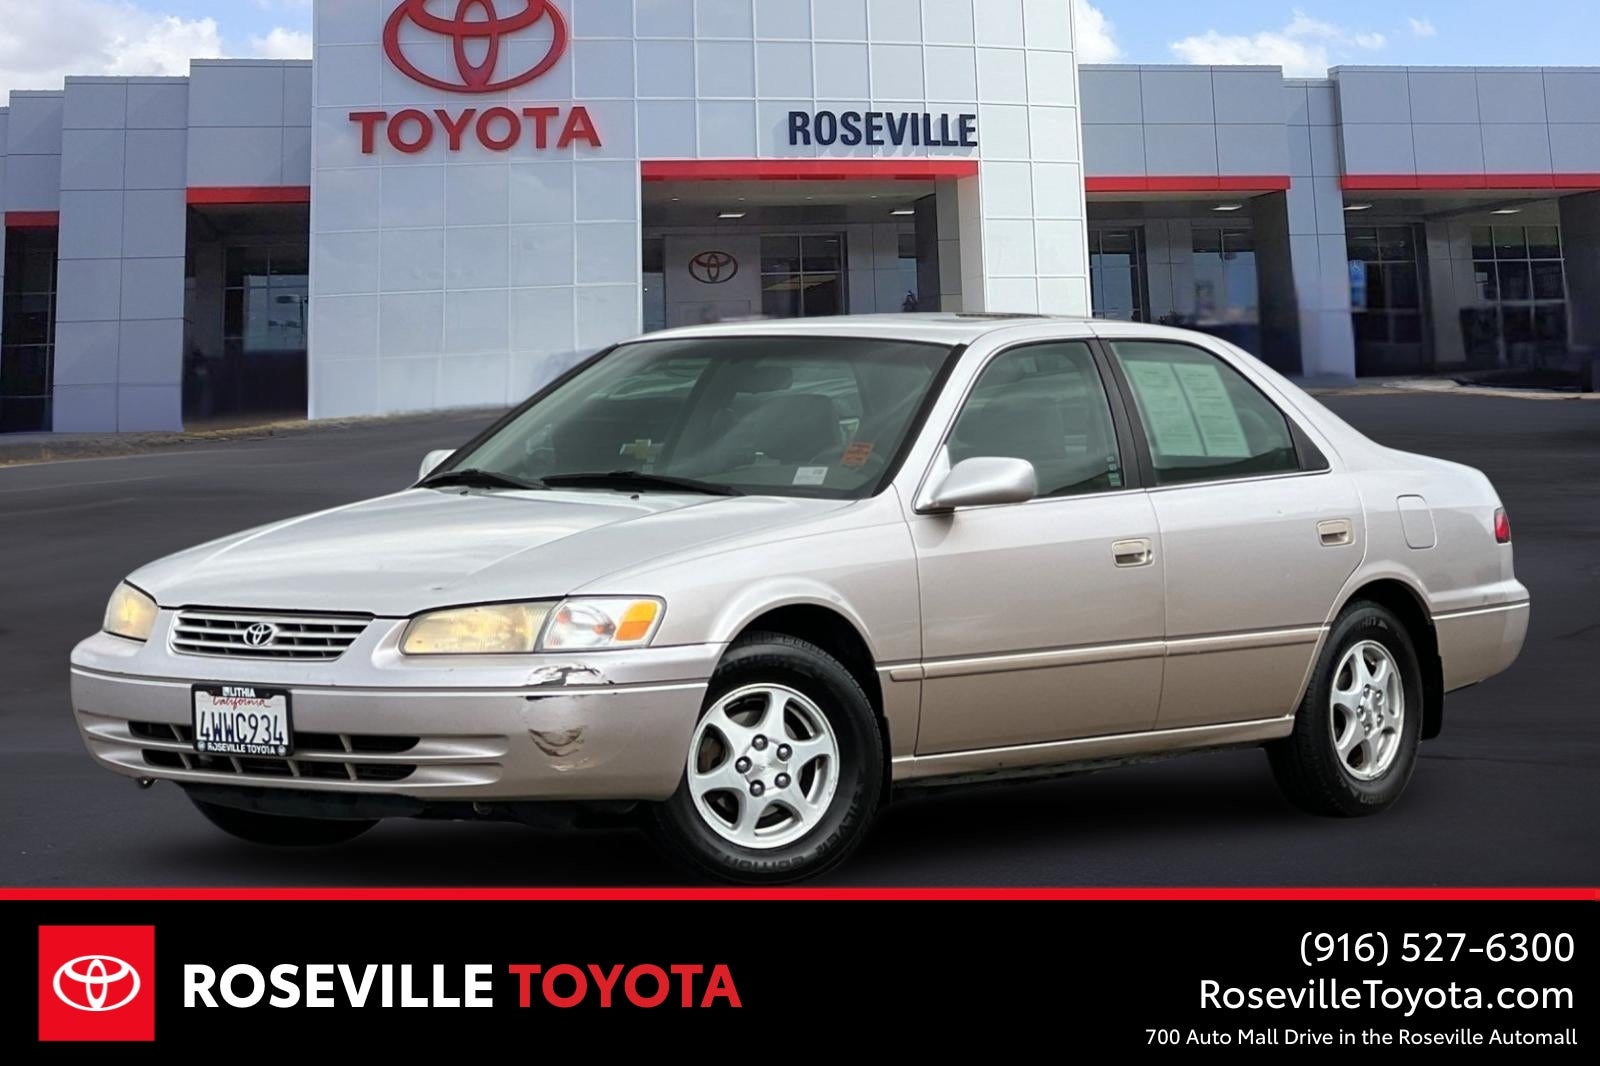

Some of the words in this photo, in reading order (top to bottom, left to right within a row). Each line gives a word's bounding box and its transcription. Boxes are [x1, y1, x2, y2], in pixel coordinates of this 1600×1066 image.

[349, 106, 602, 154] TOYOTA
[788, 110, 978, 147] ROSEVILLE
[213, 696, 271, 711] California
[229, 686, 256, 698] LITHIA
[200, 711, 284, 745] 4WWC934
[207, 742, 246, 753] ROSEVILLE
[247, 744, 276, 755] TOYOTA
